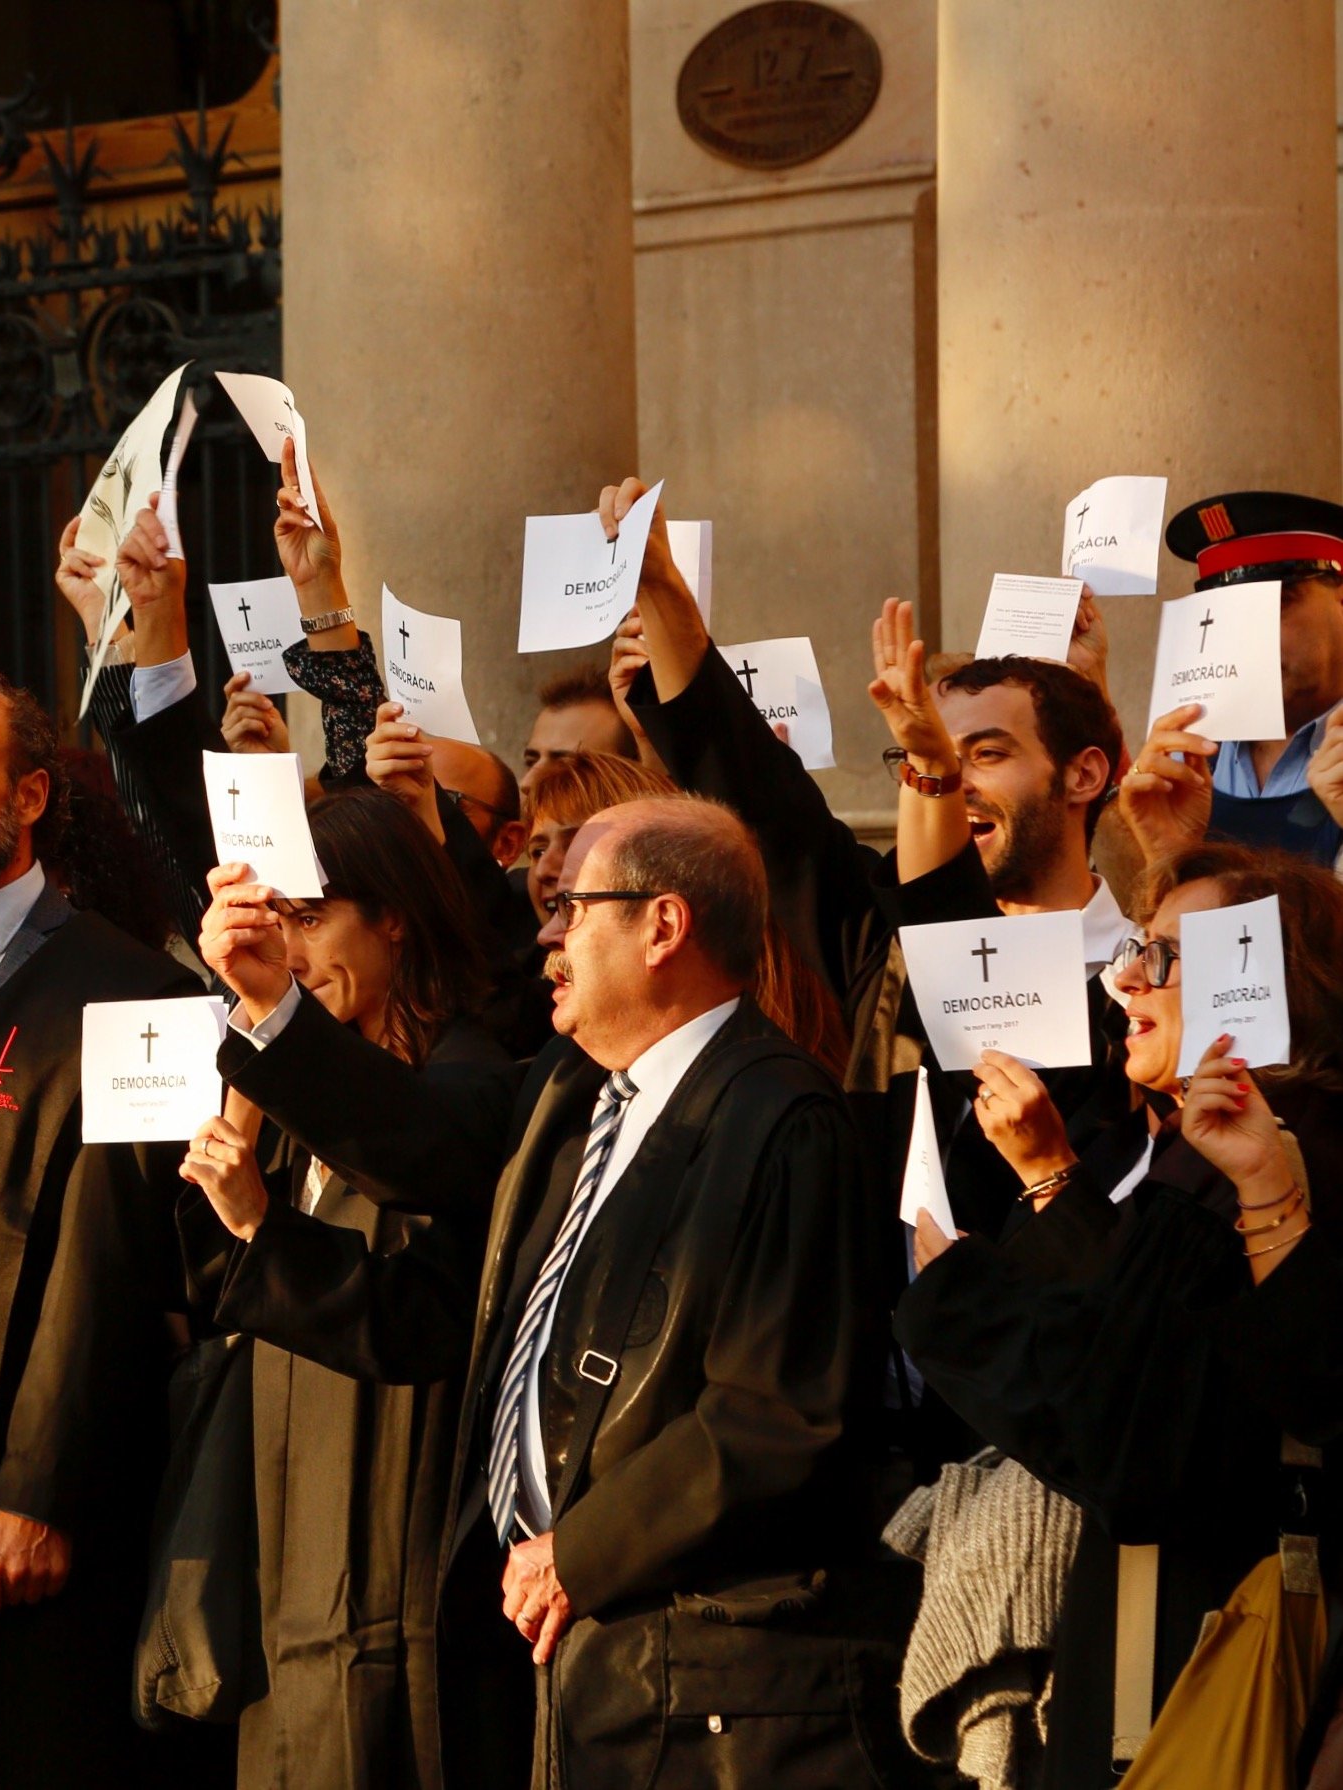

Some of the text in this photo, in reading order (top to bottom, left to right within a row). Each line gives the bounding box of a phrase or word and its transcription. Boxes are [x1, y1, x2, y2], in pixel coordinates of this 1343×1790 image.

[228, 638, 283, 654] DEMOCRÀCIA
[1171, 662, 1238, 688] DEMOCRÀCIA
[942, 991, 1042, 1014] DEMOCRÀCIA
[1003, 1020, 1018, 1029] 2017
[112, 1073, 187, 1090] DEMOCRÀCIA
